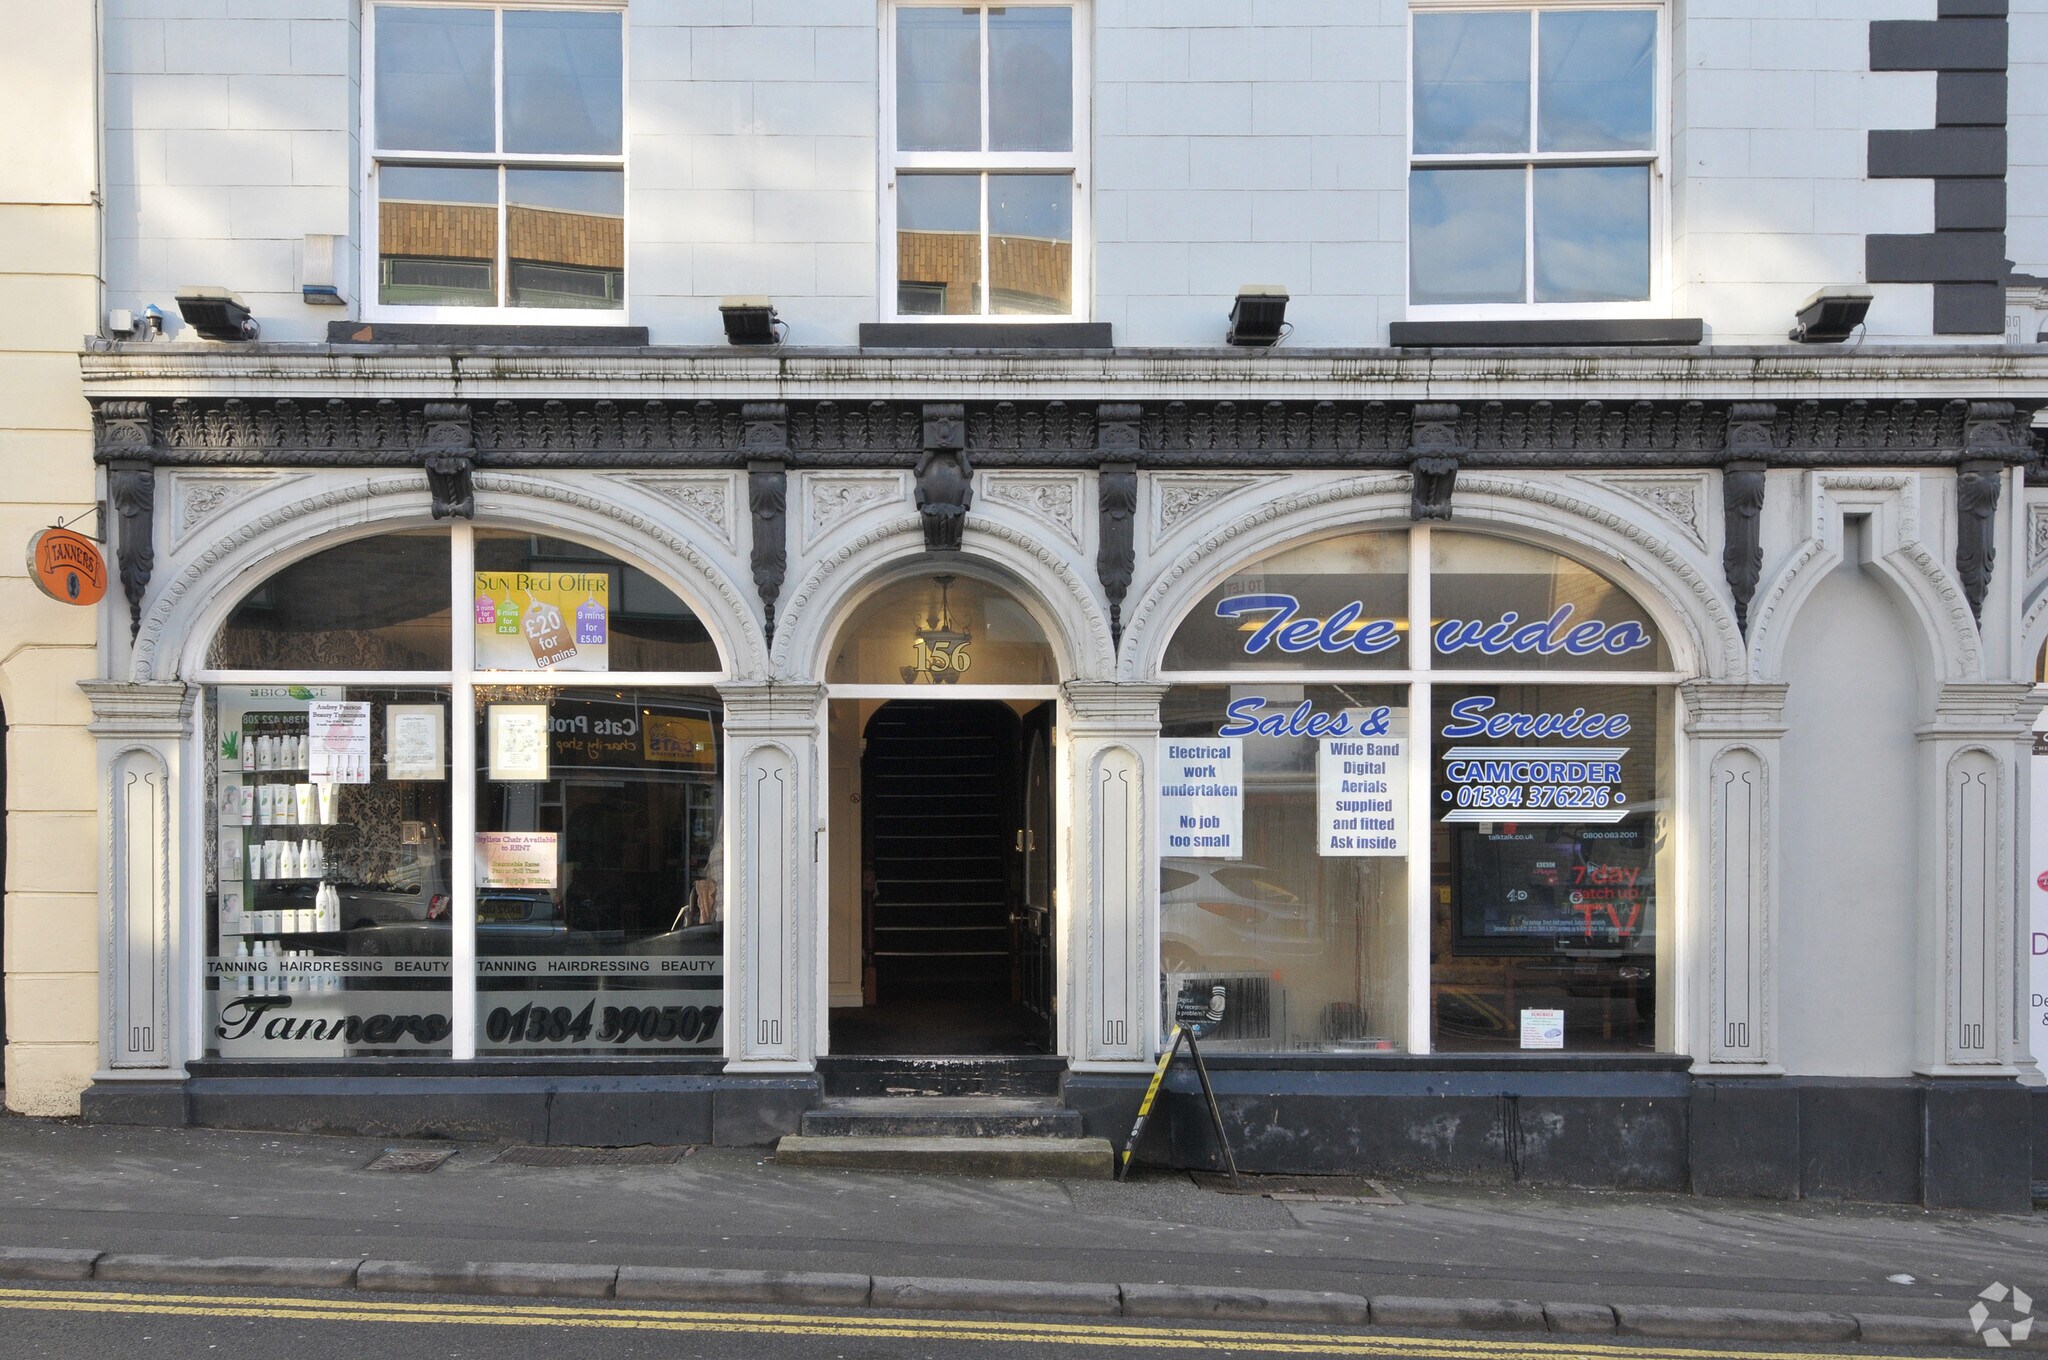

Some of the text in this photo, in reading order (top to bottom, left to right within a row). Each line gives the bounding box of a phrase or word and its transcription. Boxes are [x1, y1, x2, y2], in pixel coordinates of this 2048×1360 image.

[52, 543, 94, 573] TANNERS
[578, 612, 605, 620] 9 mins
[525, 612, 560, 639] £20
[586, 623, 598, 632] for
[1215, 593, 1651, 655] Tele video
[539, 635, 558, 650] for
[580, 636, 602, 644] £5.00
[538, 648, 576, 668] 60 mins
[913, 640, 971, 673] 156
[260, 688, 328, 697] BIOLAGE
[1218, 696, 1631, 739] Sales & Service
[1169, 746, 1231, 759] Electrical
[1330, 743, 1400, 756] Wide Band
[1184, 765, 1216, 778] work
[1344, 762, 1386, 776] Digital
[1446, 761, 1622, 783] CAMCORDER
[1162, 784, 1238, 796] undertaken
[1342, 780, 1388, 793] Aerials
[1457, 786, 1610, 808] 01384 376226
[1336, 799, 1392, 812] supplied
[1180, 816, 1220, 829] No job
[1333, 818, 1394, 830] and fitted
[1170, 834, 1230, 847] too small
[1330, 836, 1397, 849] Ask inside
[1572, 866, 1586, 884] 7
[1591, 864, 1639, 887] day
[1618, 888, 1638, 901] up
[1572, 903, 1642, 936] TV
[208, 961, 450, 972] TANNING HAIRDRESSING BEAUTY
[478, 960, 716, 972] TANNING HAIRDRESSING BEAUTY
[218, 995, 453, 1044] Tanners
[486, 997, 724, 1044] 01384 390507
